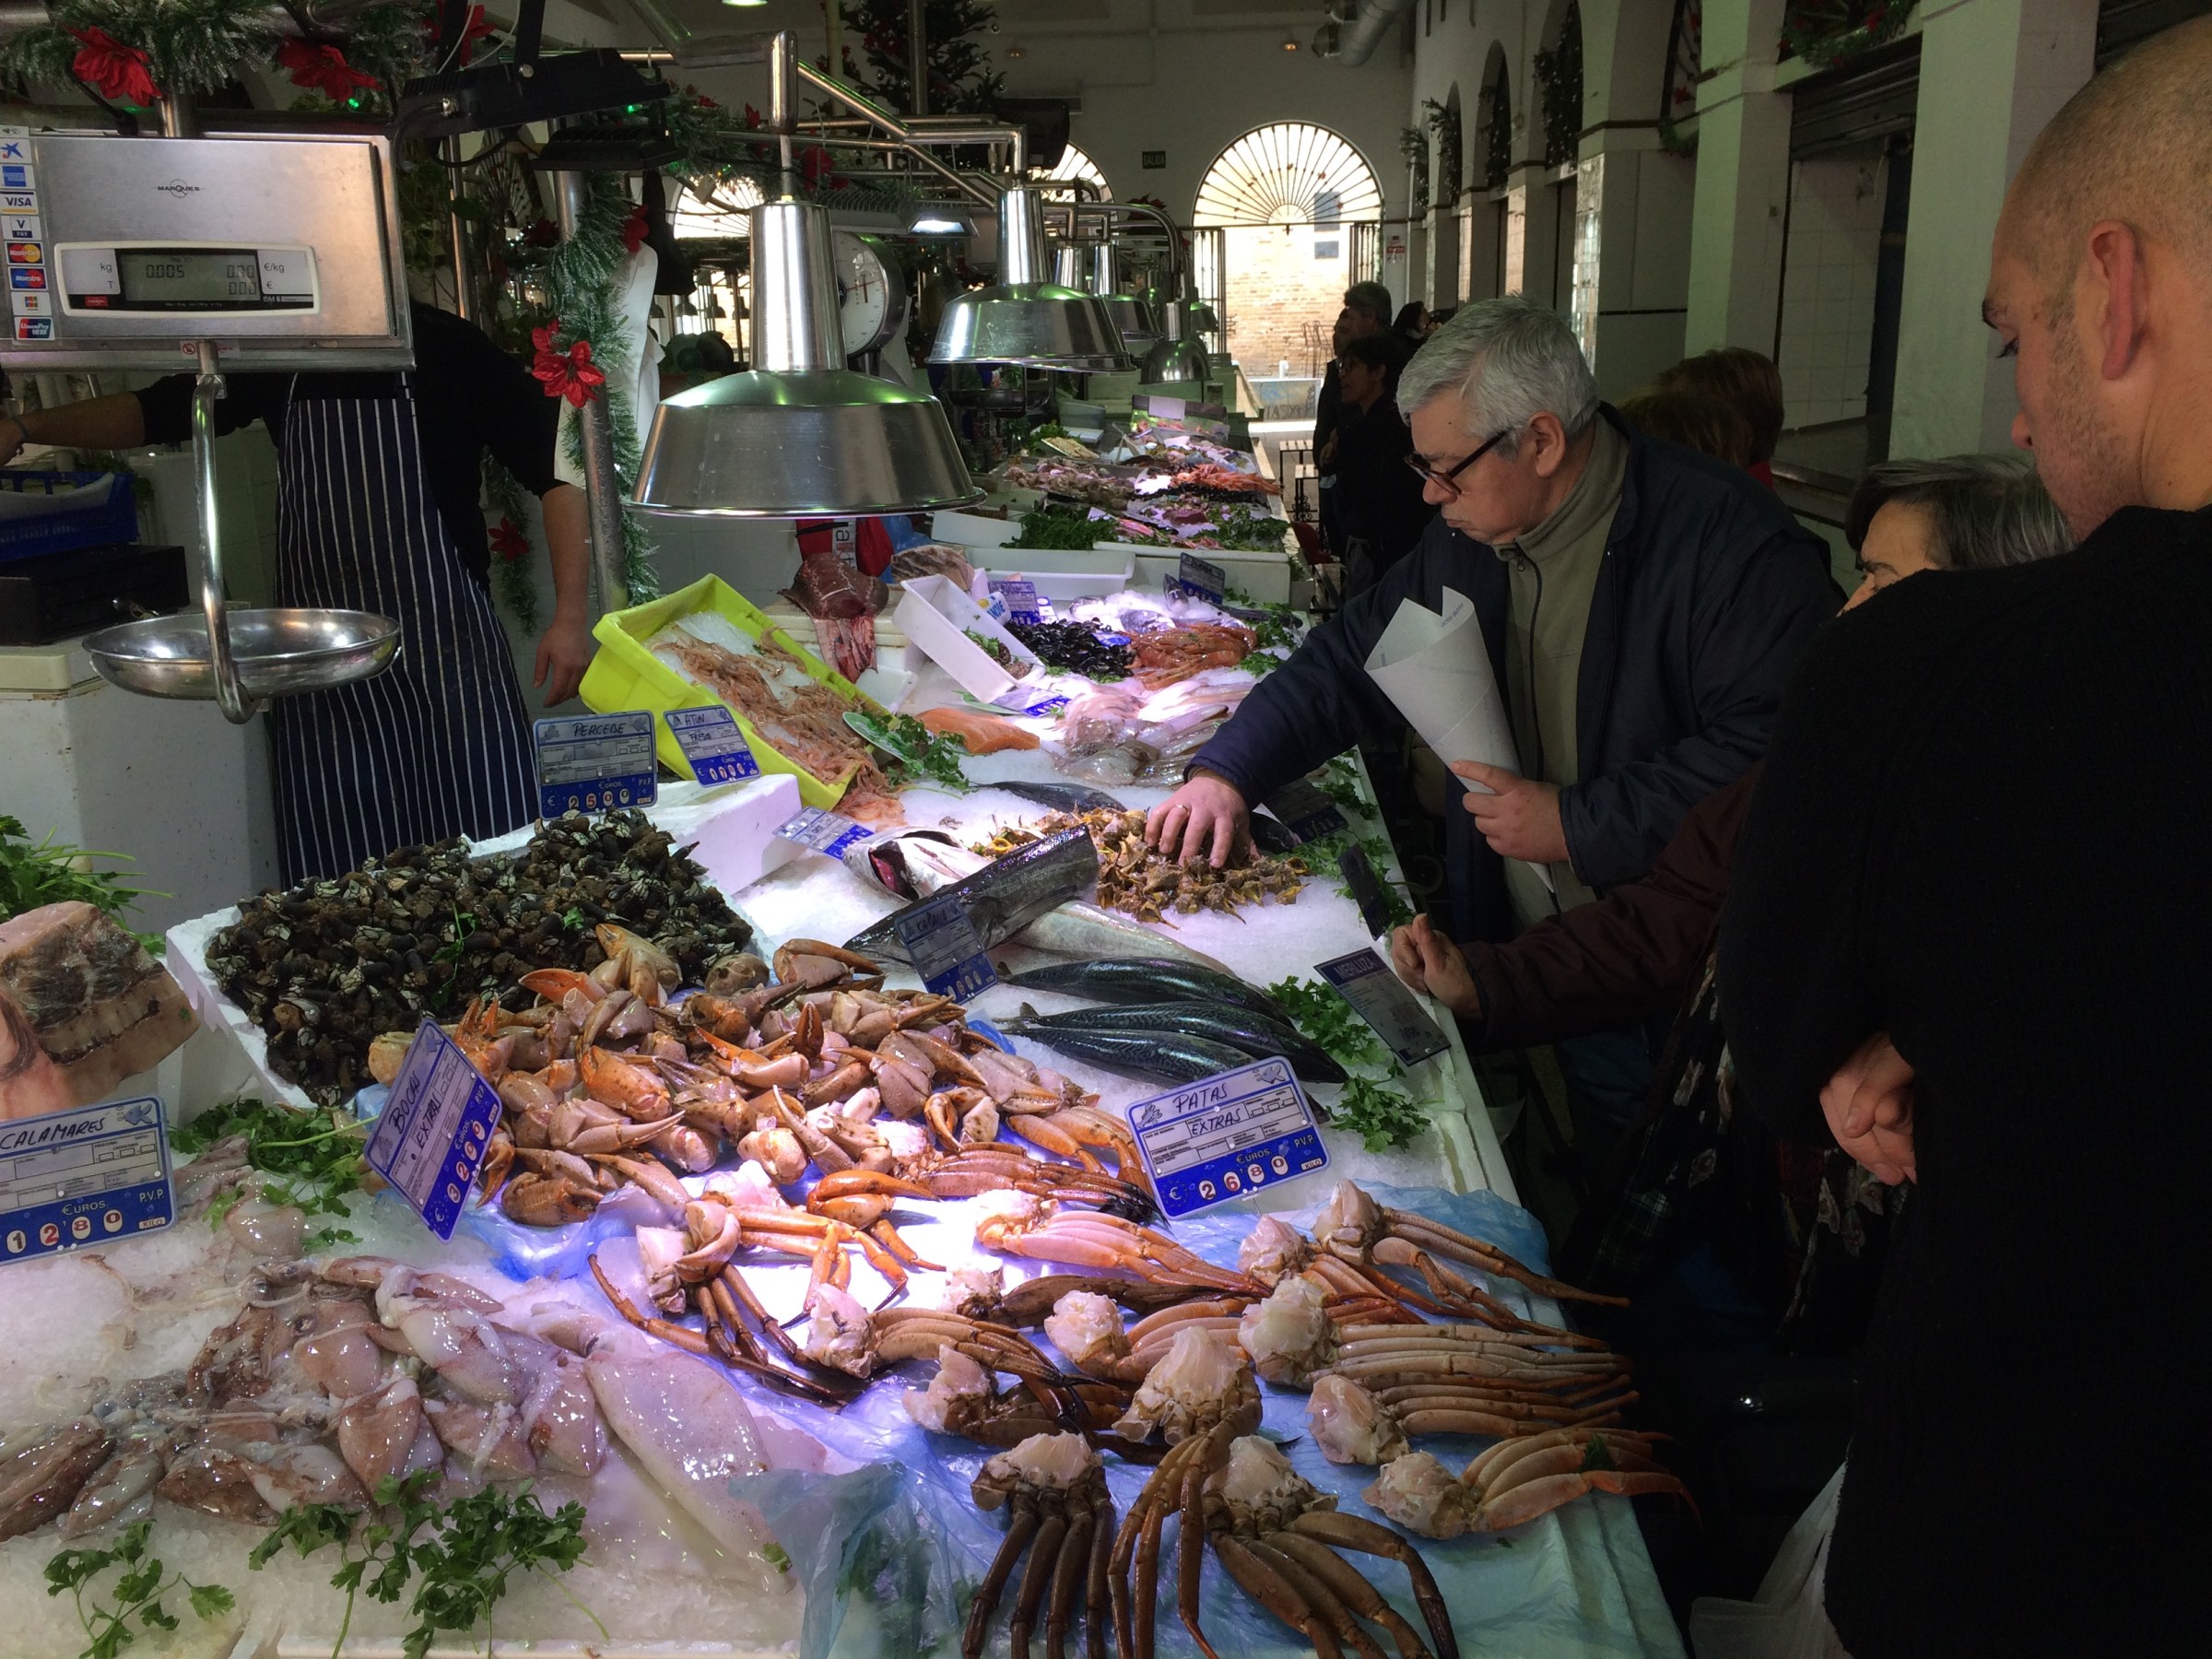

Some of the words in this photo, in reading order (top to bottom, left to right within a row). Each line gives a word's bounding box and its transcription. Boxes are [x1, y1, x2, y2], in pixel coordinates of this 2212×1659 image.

[158, 185, 200, 195] MARQUES
[4, 196, 32, 206] VISA
[17, 219, 26, 229] V
[100, 263, 112, 274] kg
[264, 263, 285, 274] €/kg
[15, 275, 41, 283] Maestro
[107, 280, 113, 289] T
[265, 280, 274, 289] €
[572, 722, 628, 736] PERCEBE
[547, 795, 556, 806] €
[1333, 956, 1377, 980] MERLUZA
[388, 1070, 420, 1135] BOCAS
[1172, 1083, 1229, 1113] PATAS
[416, 1094, 441, 1148] EXTRAS
[1191, 1109, 1241, 1135] EXTRAS
[0, 1117, 106, 1149] CALAMARES
[1304, 1159, 1321, 1171] KILO
[139, 1188, 165, 1203] P.V.P.
[1168, 1186, 1182, 1201] €
[433, 1208, 445, 1223] €
[142, 1218, 163, 1228] KILO
